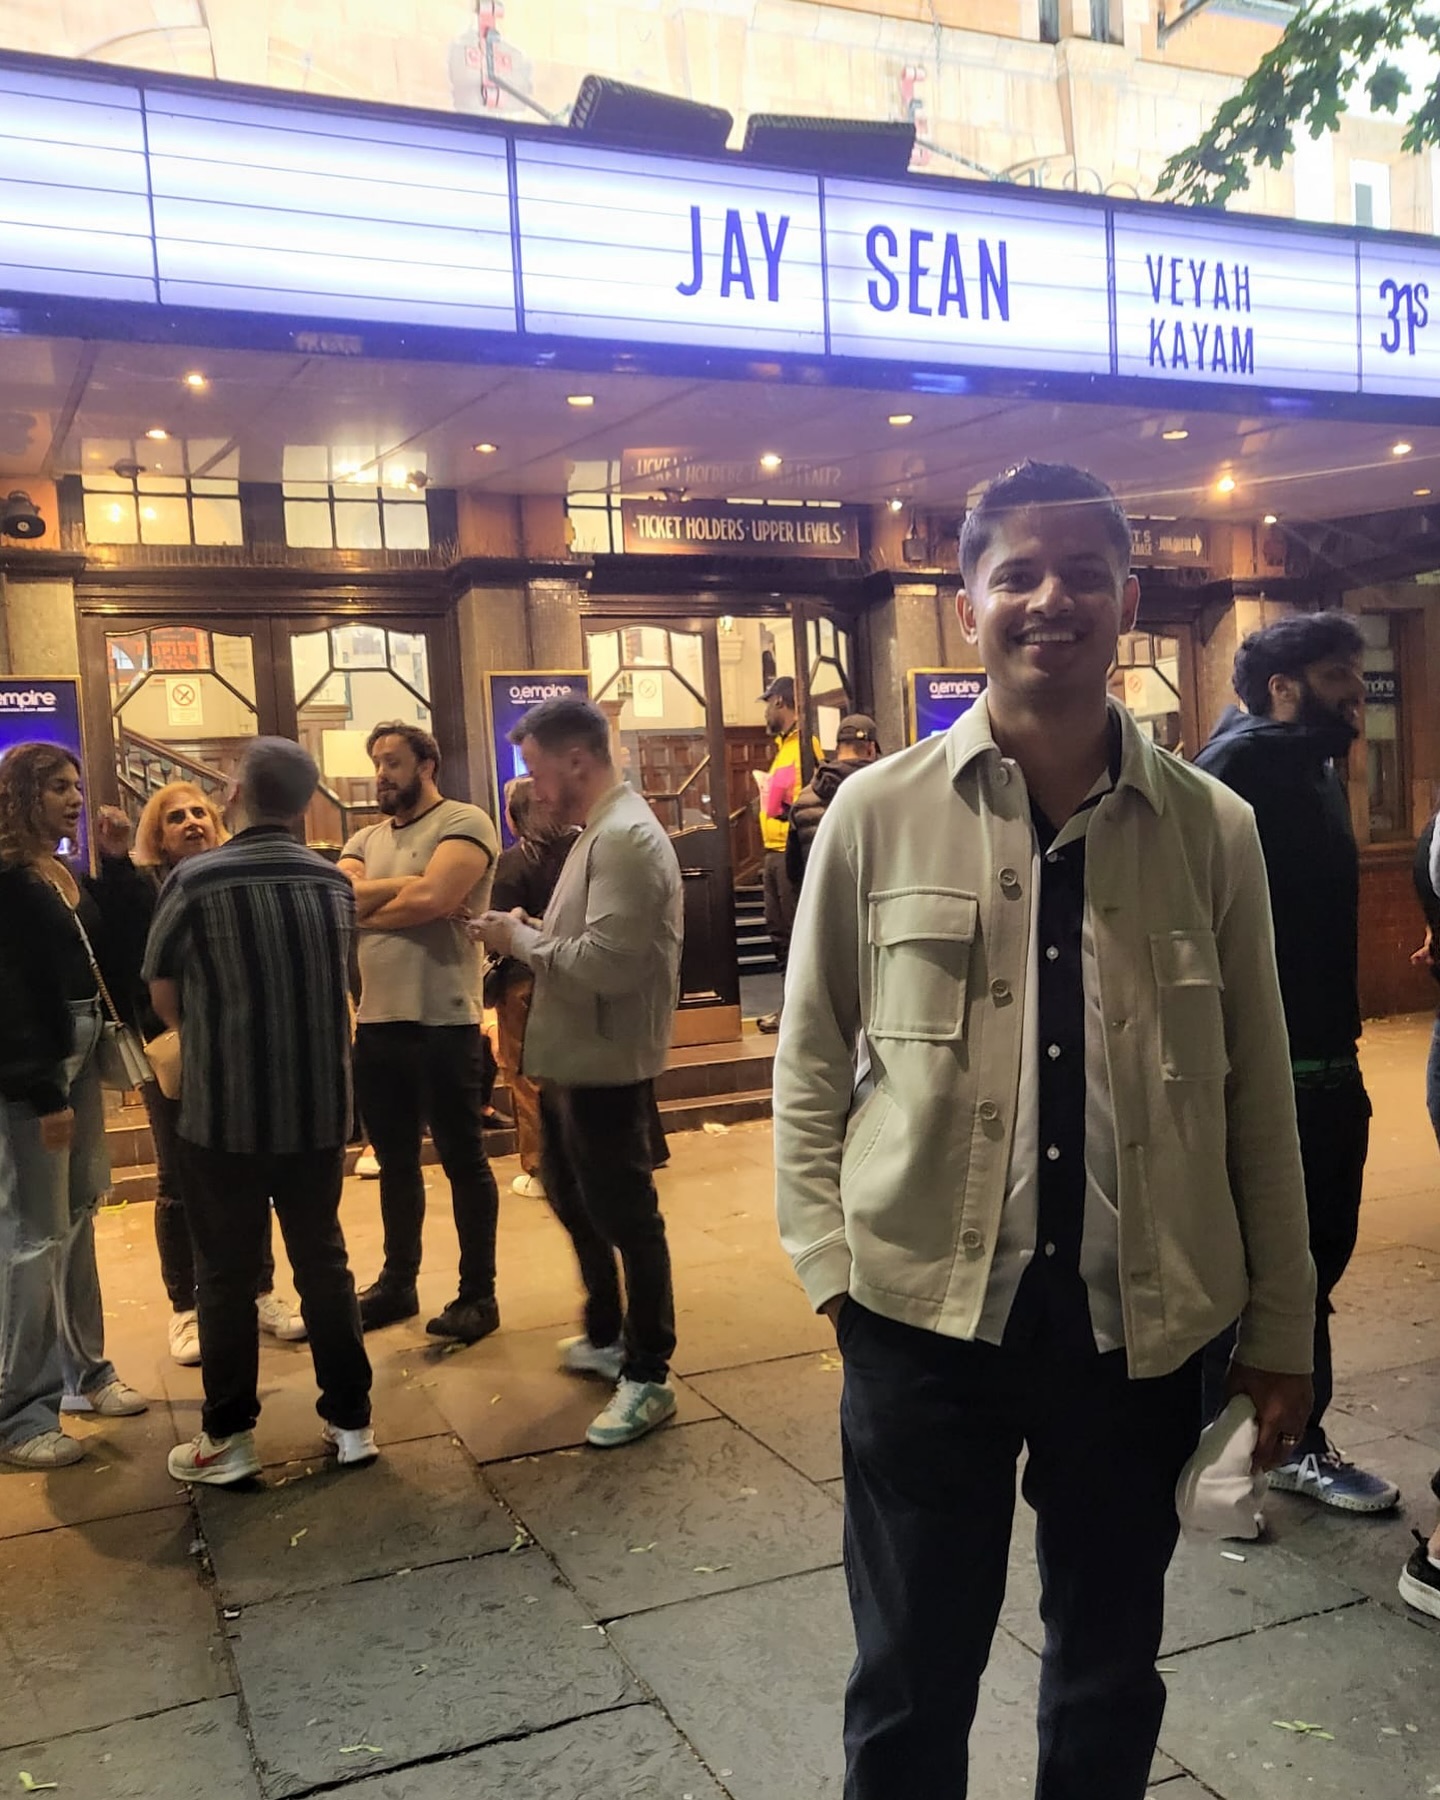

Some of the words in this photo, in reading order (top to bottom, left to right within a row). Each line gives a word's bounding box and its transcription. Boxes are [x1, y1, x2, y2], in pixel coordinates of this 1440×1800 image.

[675, 204, 790, 302] JAY
[866, 224, 1009, 322] SEAN
[1146, 253, 1251, 313] VEYAH
[1149, 317, 1254, 375] KAYAM
[636, 515, 682, 539] TICKET
[685, 517, 745, 541] HOLDERS
[751, 520, 794, 543] UPPER
[796, 521, 841, 545] LEVELS
[0, 689, 57, 708] mpire
